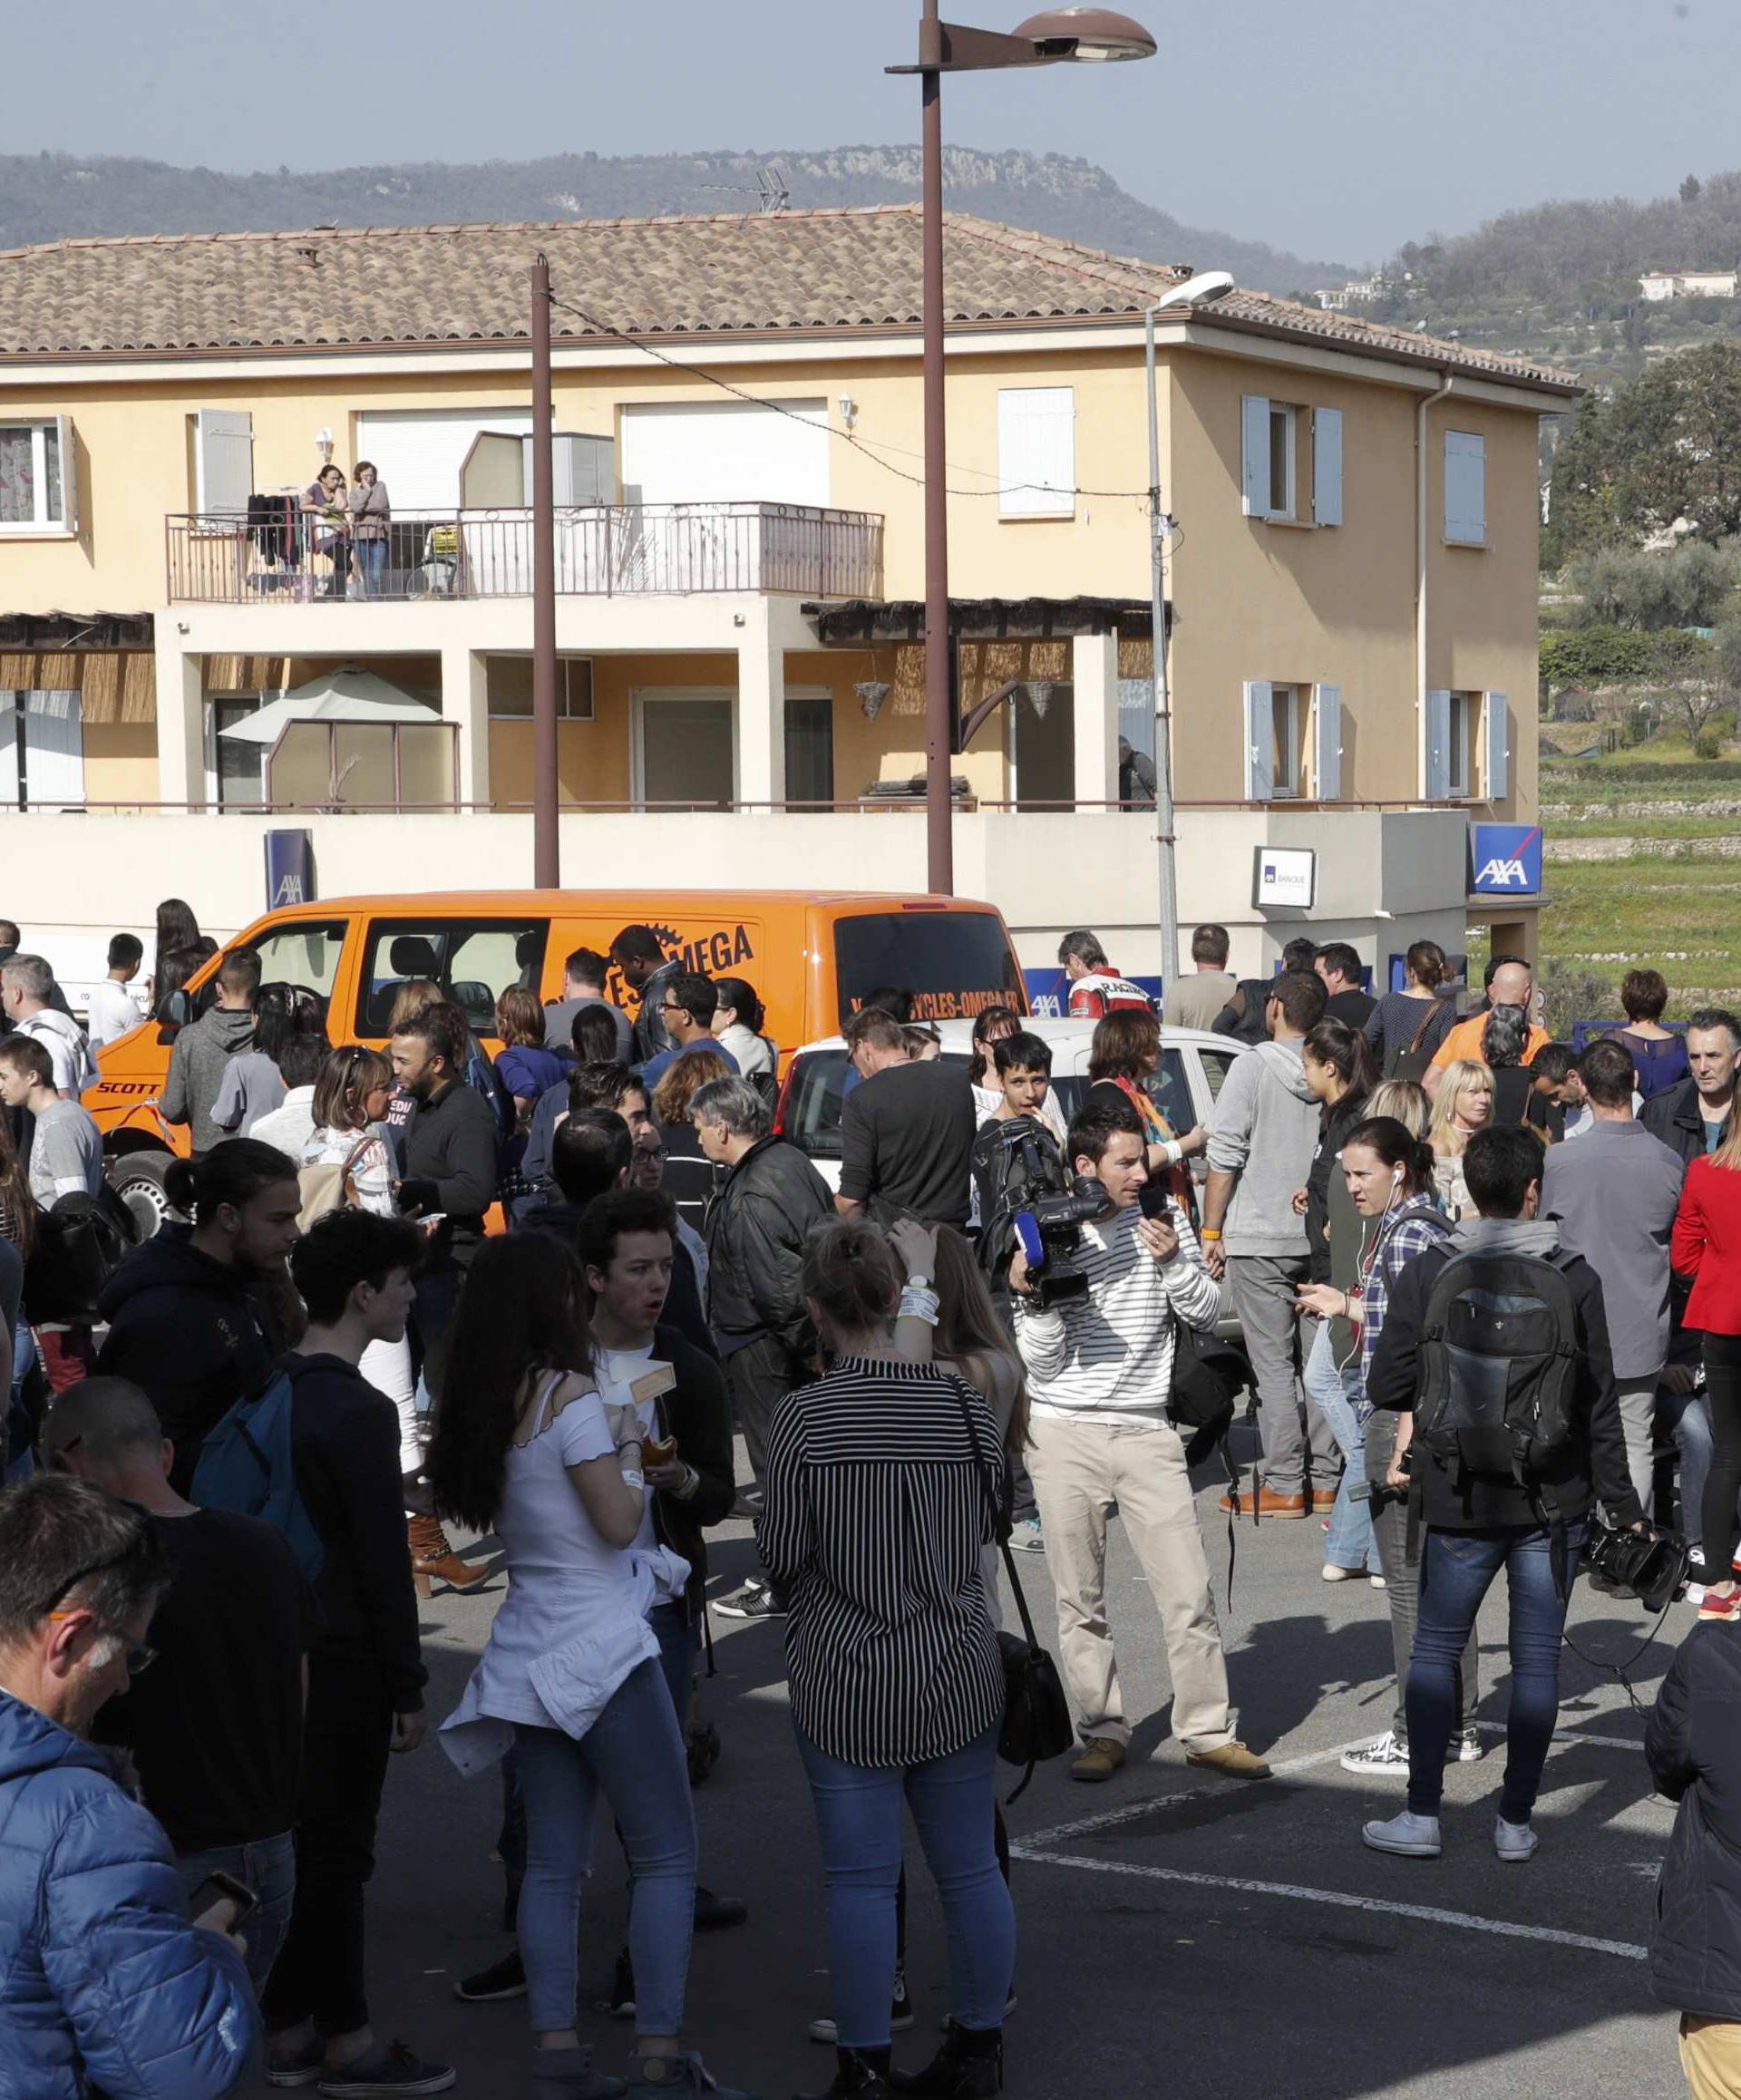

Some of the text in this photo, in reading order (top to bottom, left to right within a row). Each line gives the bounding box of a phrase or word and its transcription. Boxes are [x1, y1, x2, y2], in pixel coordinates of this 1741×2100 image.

[1475, 859, 1528, 885] AXA
[275, 874, 305, 905] AXA
[669, 924, 754, 976] MEGA
[1030, 995, 1063, 1017] AXA
[96, 1082, 160, 1094] SCOTT
